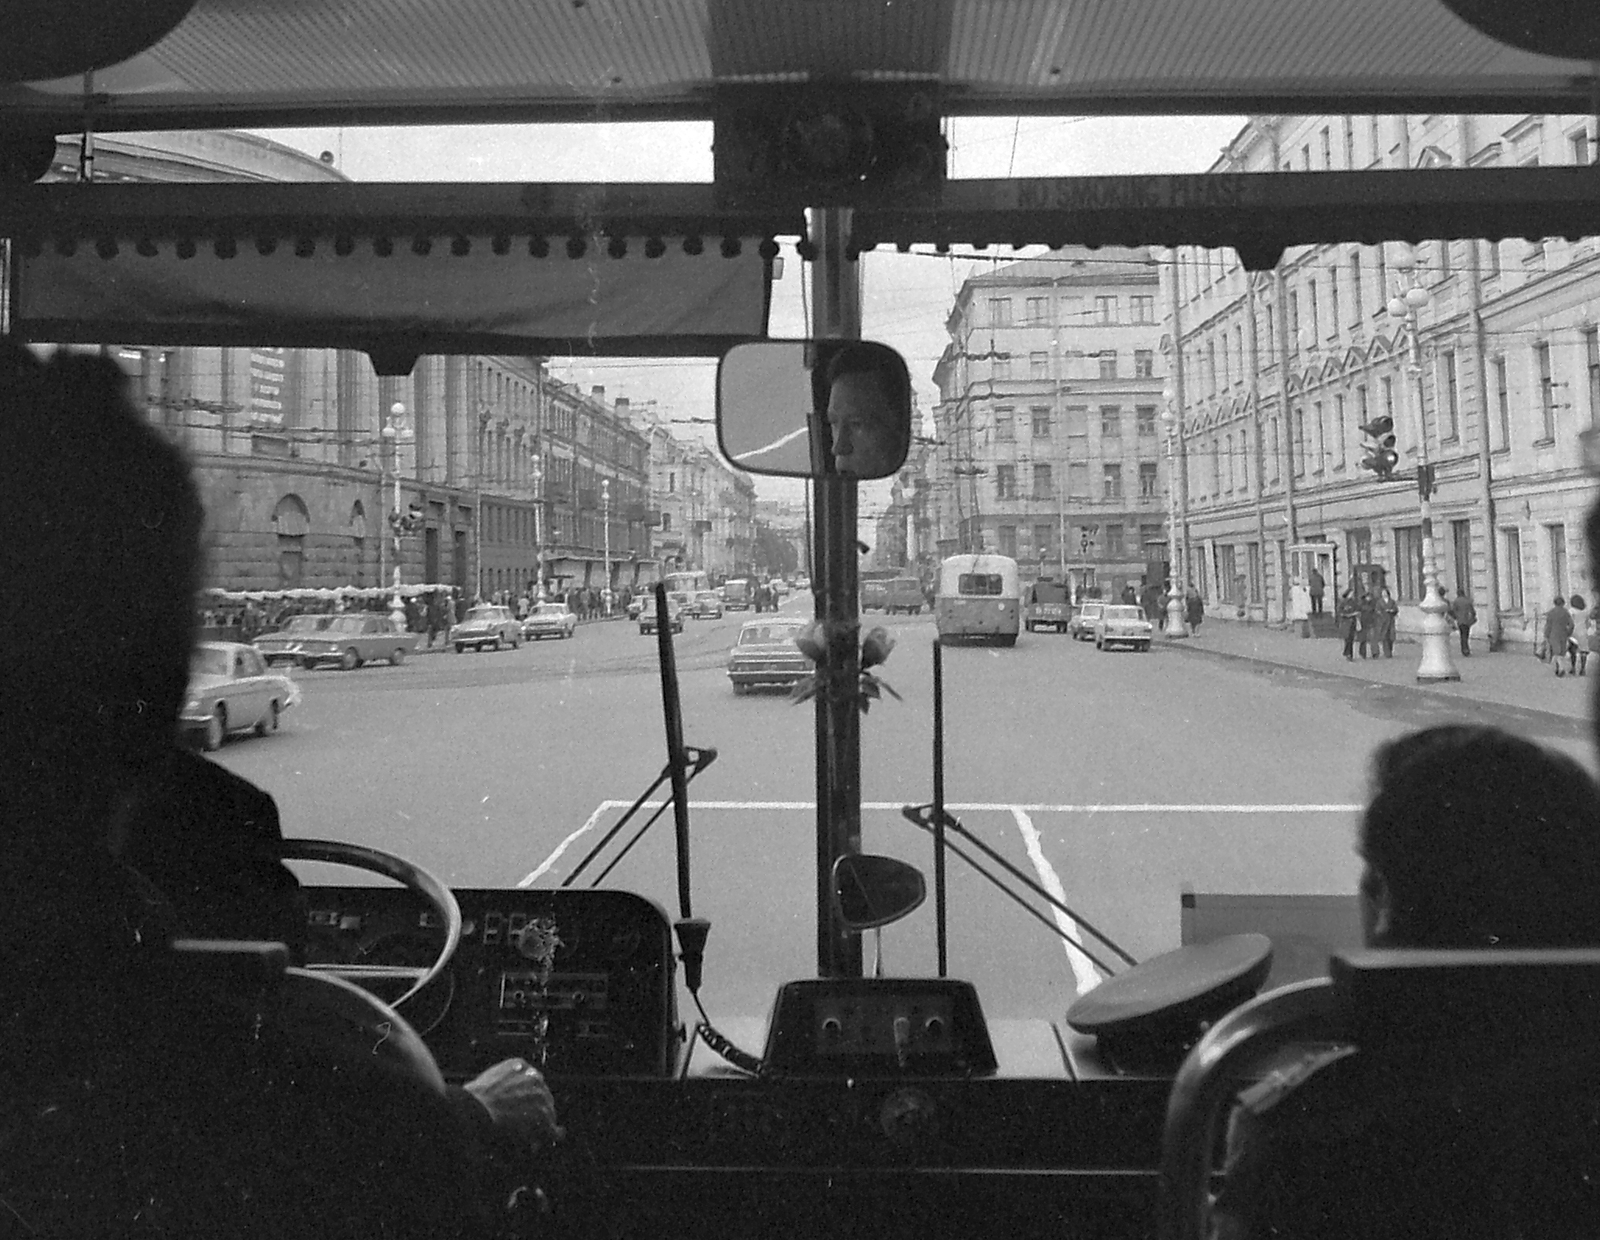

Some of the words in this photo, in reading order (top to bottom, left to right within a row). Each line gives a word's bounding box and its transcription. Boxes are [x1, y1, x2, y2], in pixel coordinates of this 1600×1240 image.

[1018, 181, 1048, 209] NO
[1057, 180, 1159, 208] SMOKING
[1169, 178, 1247, 206] PLEASE
